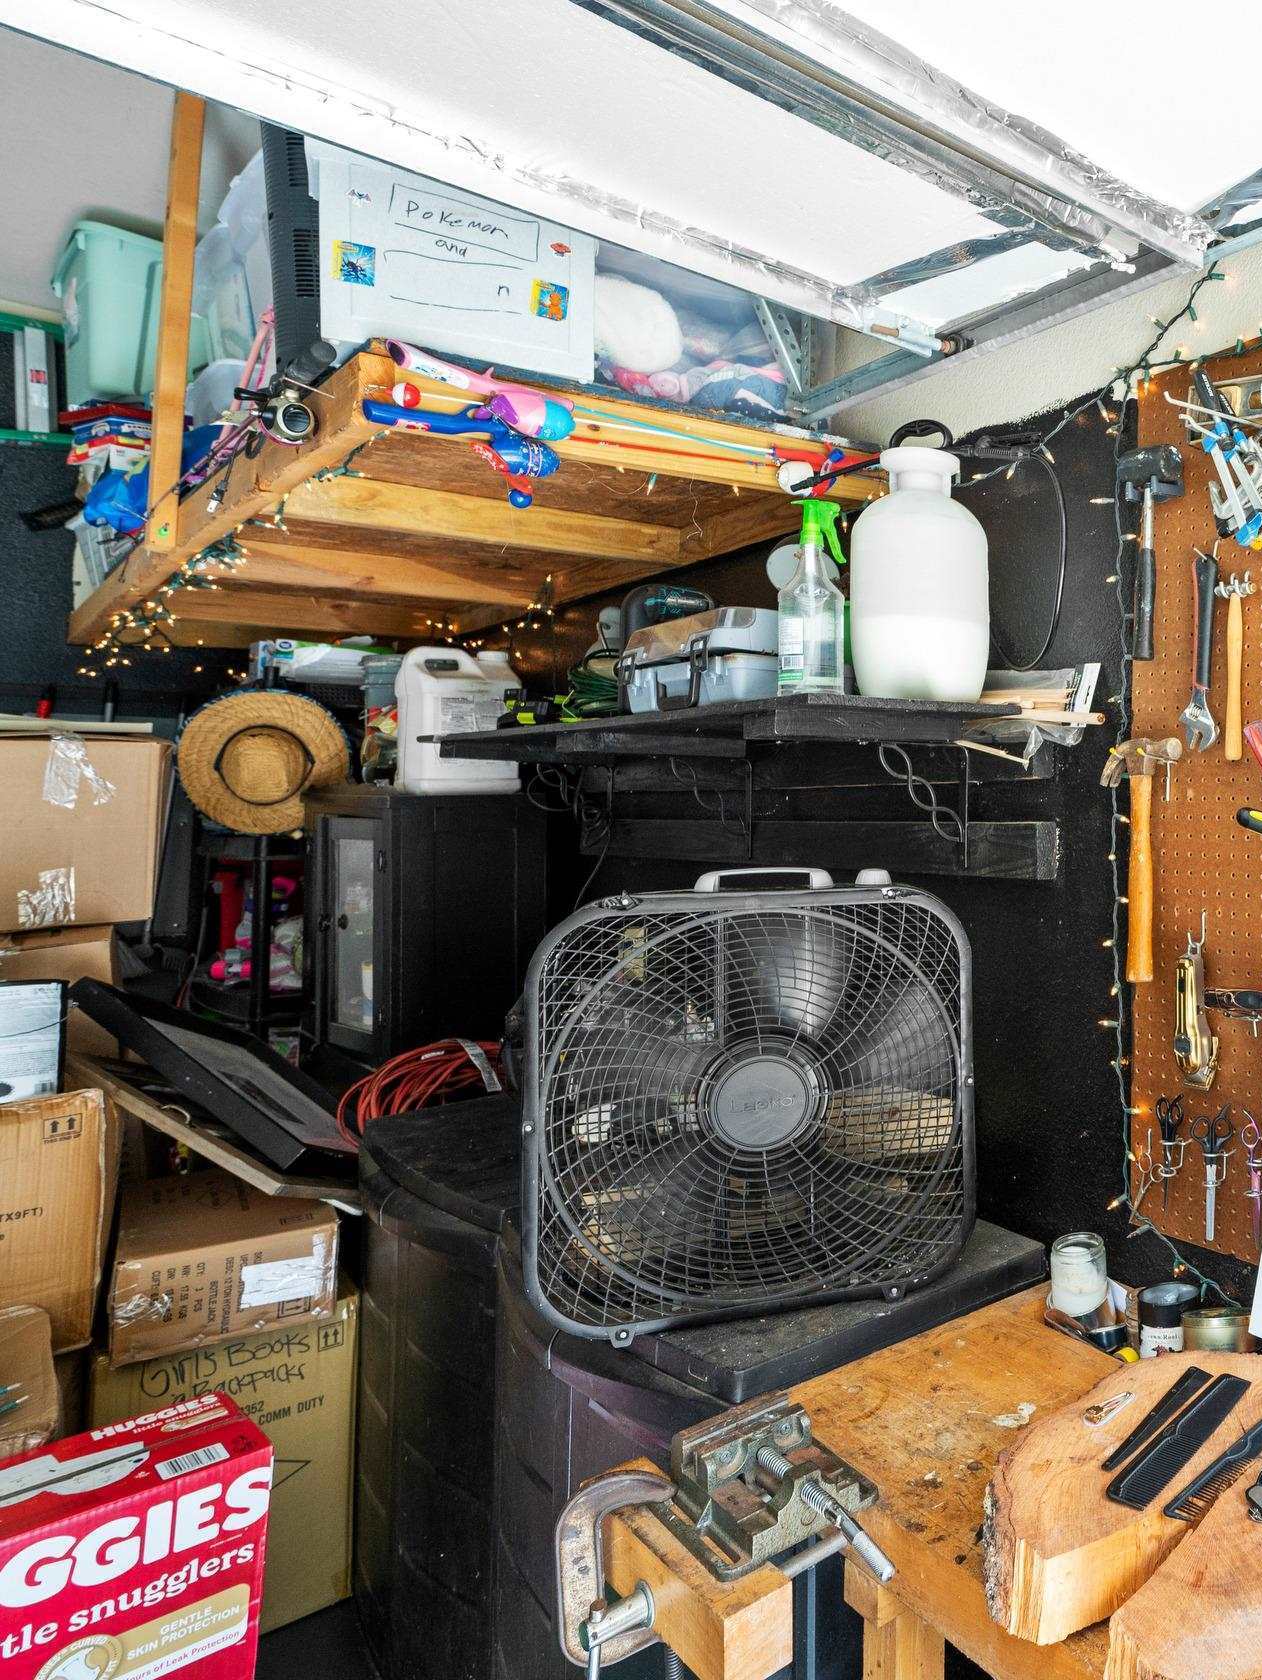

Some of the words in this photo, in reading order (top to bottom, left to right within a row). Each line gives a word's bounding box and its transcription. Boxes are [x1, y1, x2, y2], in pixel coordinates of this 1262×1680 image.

[404, 199, 511, 240] Pokemon
[434, 238, 468, 258] and
[223, 1332, 312, 1367] Books
[90, 1393, 219, 1441] HUGGIES
[258, 1407, 293, 1426] COMM
[297, 1394, 325, 1414] DUTY
[67, 1542, 255, 1633] snugglers
[126, 1639, 160, 1661] SKIN
[162, 1604, 241, 1648] PROTECTION
[159, 1605, 213, 1636] GENTLE
[165, 1652, 189, 1668] Leak
[191, 1630, 240, 1658] Protection
